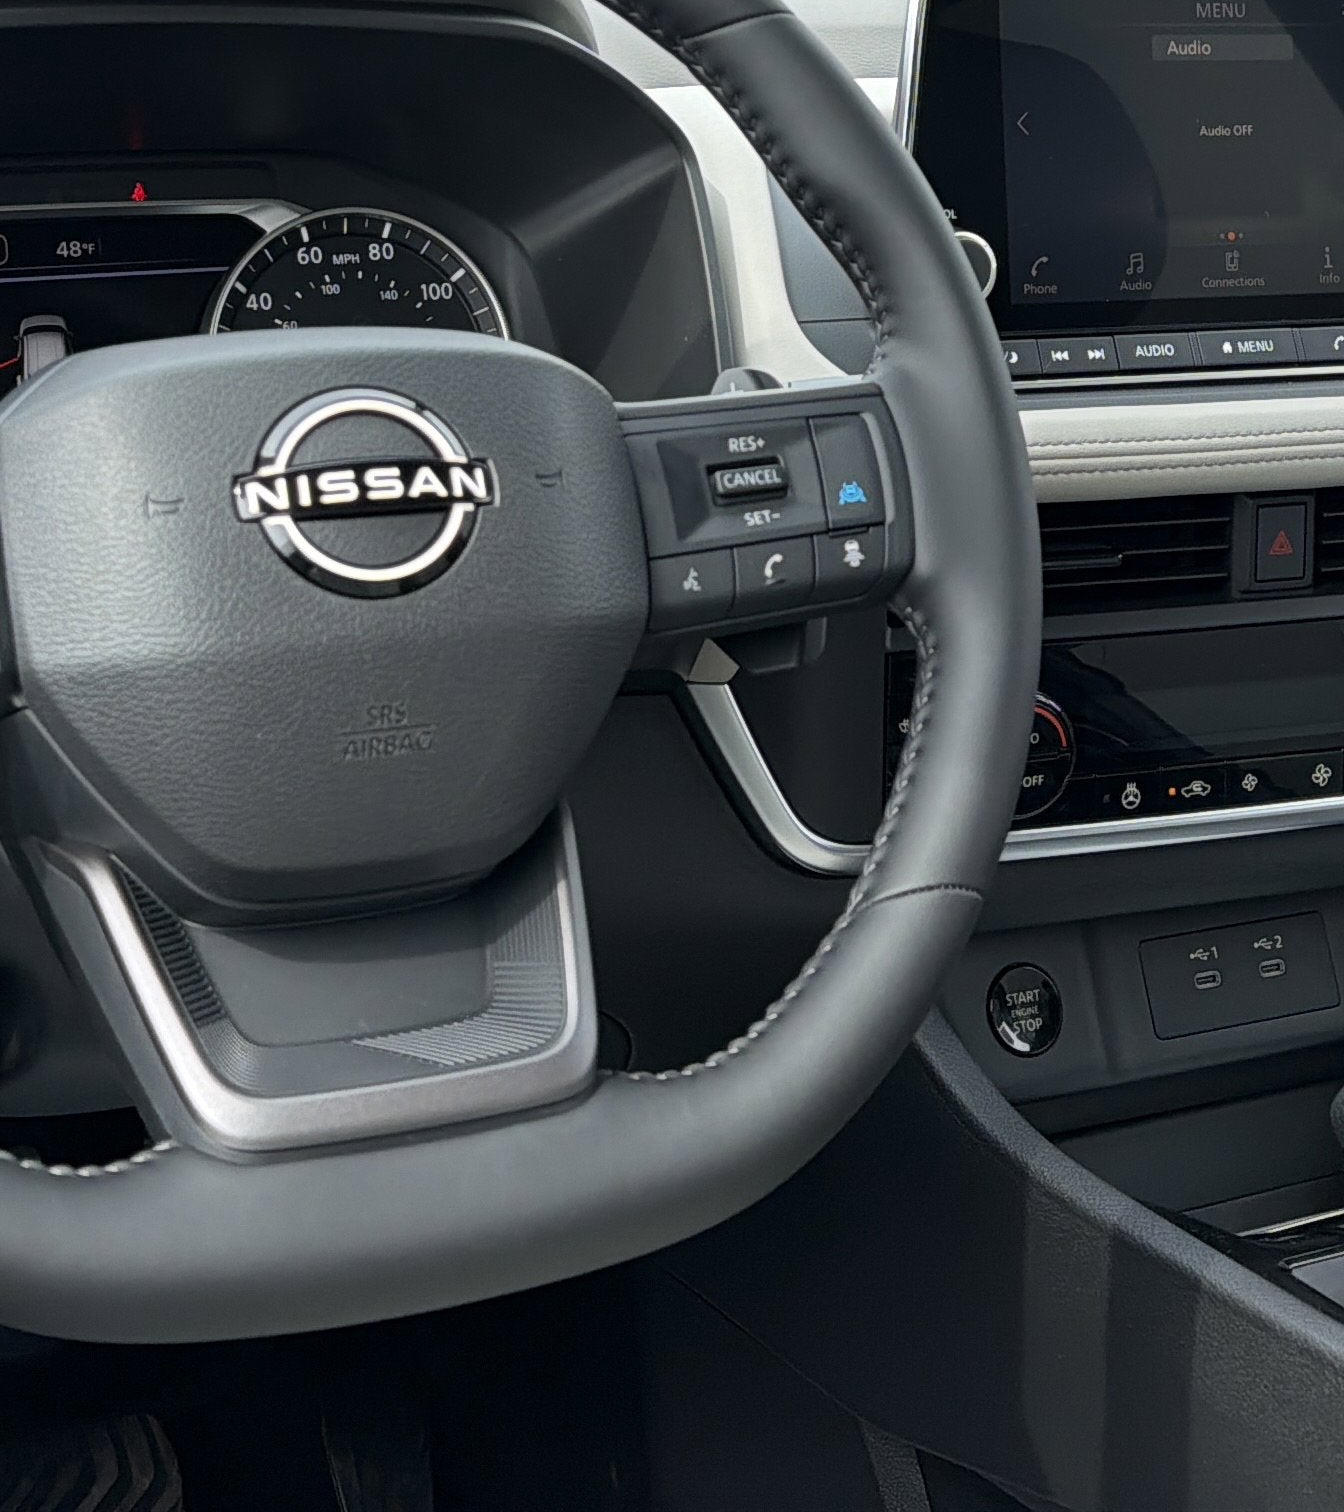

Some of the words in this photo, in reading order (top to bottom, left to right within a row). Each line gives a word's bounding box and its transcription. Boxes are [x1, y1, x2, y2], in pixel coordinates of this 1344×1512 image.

[1196, 2, 1246, 18] MENU
[1167, 40, 1212, 56] Audio
[1199, 125, 1231, 137] Audio
[1233, 124, 1254, 136] OFF
[943, 208, 958, 219] OL
[297, 246, 323, 264] 60
[368, 242, 394, 260] 80
[332, 253, 360, 265] MPH
[1023, 284, 1058, 295] Phone
[1120, 279, 1152, 291] Audio
[1202, 275, 1265, 288] Connections
[1319, 272, 1341, 284] Info
[246, 292, 272, 311] 40
[420, 282, 453, 300] 100
[321, 284, 340, 295] 100
[379, 289, 398, 301] 140
[1135, 345, 1175, 357] AUDIO
[1237, 340, 1274, 354] MENU
[724, 468, 782, 487] CANCEL
[243, 466, 488, 515] NISSAN
[366, 701, 408, 727] SRS
[342, 731, 434, 761] AIRBAG
[1022, 774, 1045, 788] OFF
[1273, 934, 1284, 949] 2
[1210, 945, 1219, 960] 1
[1005, 989, 1040, 1006] START
[1011, 1004, 1040, 1018] ENGINE
[1013, 1017, 1043, 1035] STOP
